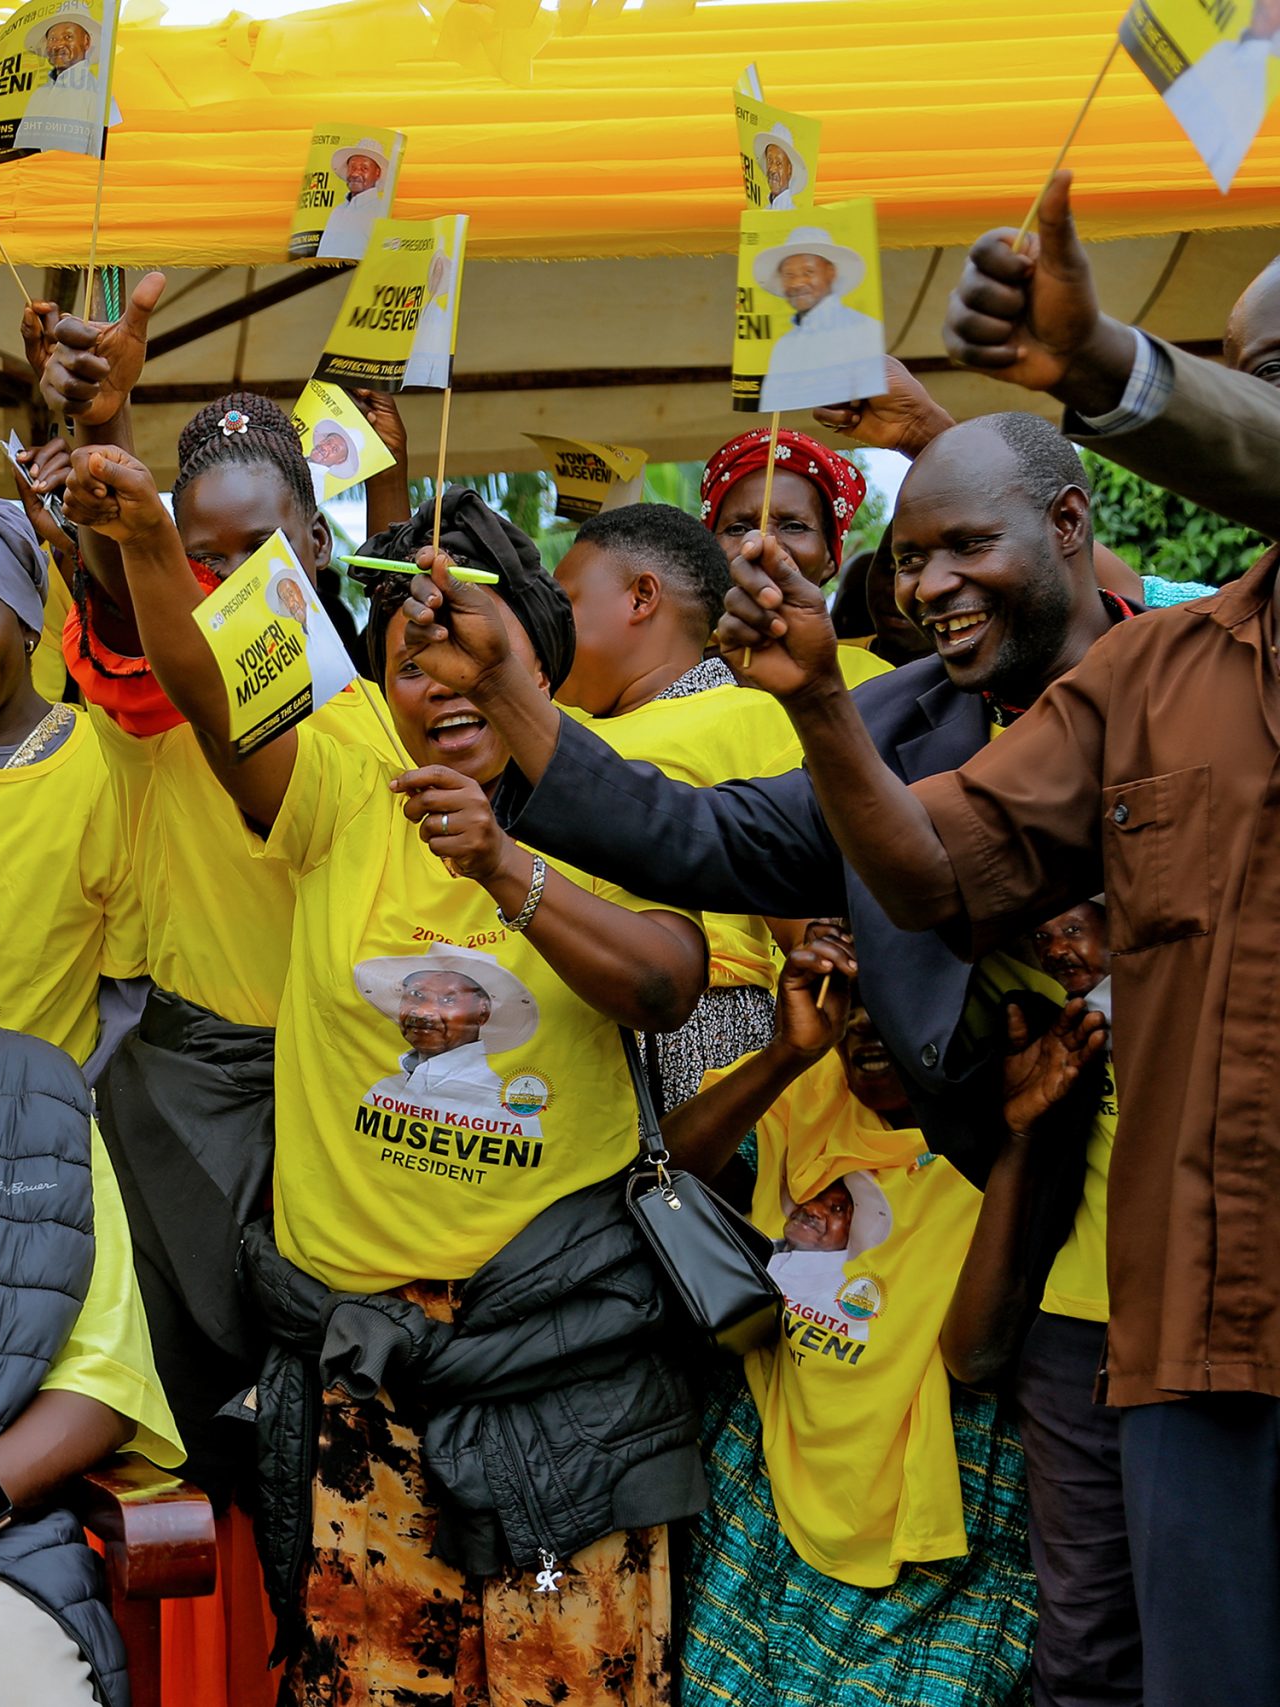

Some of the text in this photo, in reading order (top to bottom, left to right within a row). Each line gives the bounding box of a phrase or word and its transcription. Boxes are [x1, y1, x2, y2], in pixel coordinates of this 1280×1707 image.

[372, 284, 426, 309] YOWERI
[347, 306, 419, 332] MUSEVEN
[555, 463, 612, 484] MUSEVENI
[223, 582, 256, 621] PRESIDENT
[235, 620, 286, 678] YOWERI
[235, 634, 304, 708] MUSEVENI
[292, 690, 311, 710] GAINS
[466, 928, 507, 949] 2031
[371, 1093, 523, 1137] YOWERI KAGUTA
[354, 1105, 544, 1168] MUSEVENI
[380, 1147, 487, 1185] PRESIDENT
[783, 1310, 866, 1366] VENI
